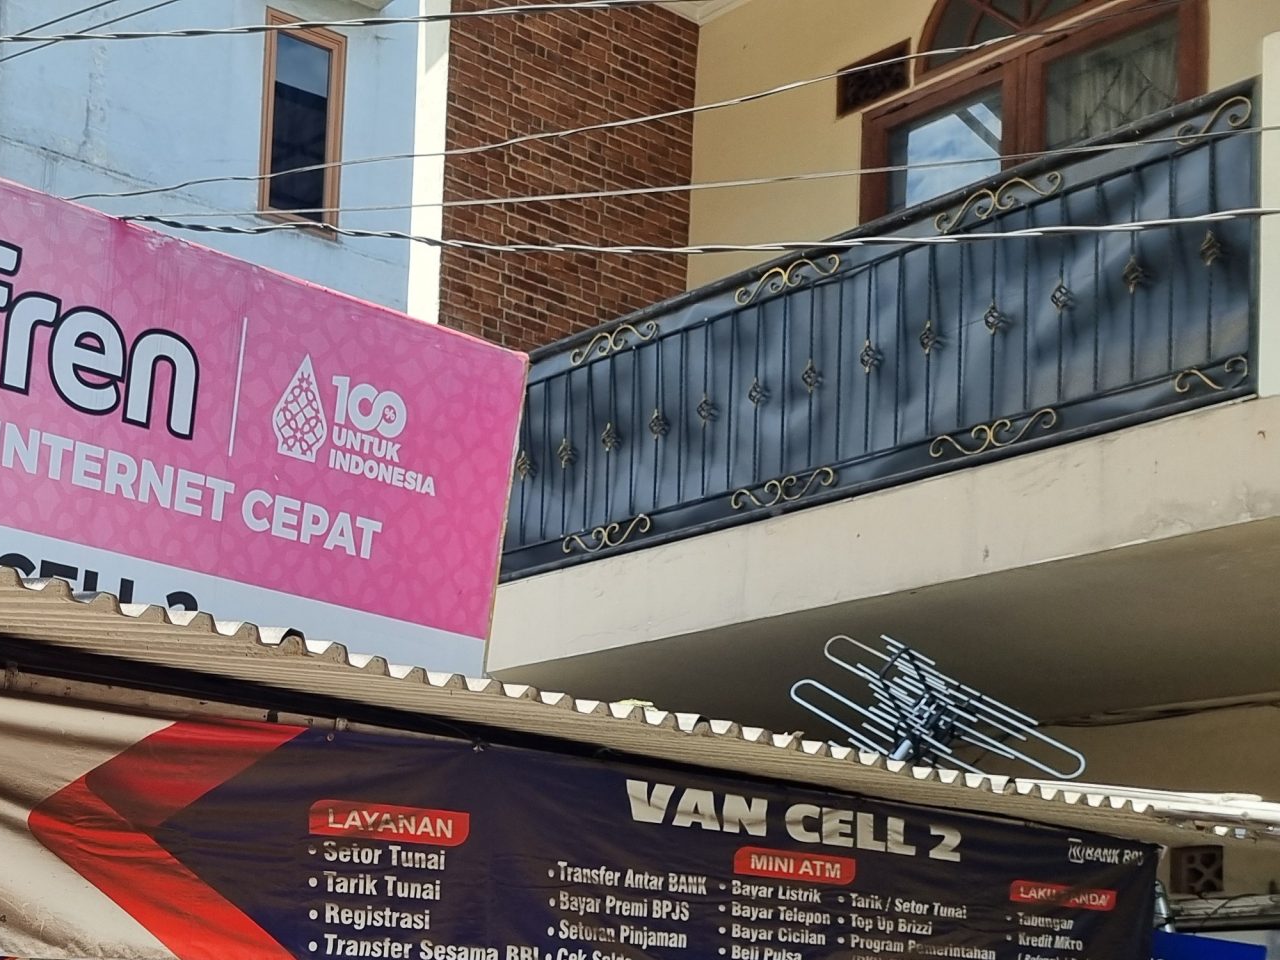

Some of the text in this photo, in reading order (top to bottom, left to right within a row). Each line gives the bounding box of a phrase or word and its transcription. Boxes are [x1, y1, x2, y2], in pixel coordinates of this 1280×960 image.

[332, 426, 402, 463] UNTUK
[329, 450, 436, 496] INDONESIA
[242, 489, 382, 559] CEPAT
[327, 808, 454, 838] LAYANAN
[625, 778, 962, 862] VAN CELL 2
[324, 841, 446, 871] Setor Tunai
[751, 854, 841, 879] MINI ATM
[323, 870, 441, 901] Tarik Tunai
[558, 861, 707, 895] Transfer Antar BANK
[732, 880, 821, 903] Bayar Listrik
[325, 902, 431, 931] Registrasi
[559, 891, 690, 921] Bayar Premi BPJS
[732, 902, 831, 926] Bayar Telepon
[850, 892, 968, 919] Tarik Setor Tunai
[558, 919, 687, 949] Setoran Pinjaman
[731, 923, 826, 946] Bayar Cicilan
[850, 914, 933, 936] Top Up Brizzi
[324, 933, 412, 960] Transfer
[850, 934, 996, 960] Program Pemerintahan
[1018, 932, 1053, 948] Kredit
